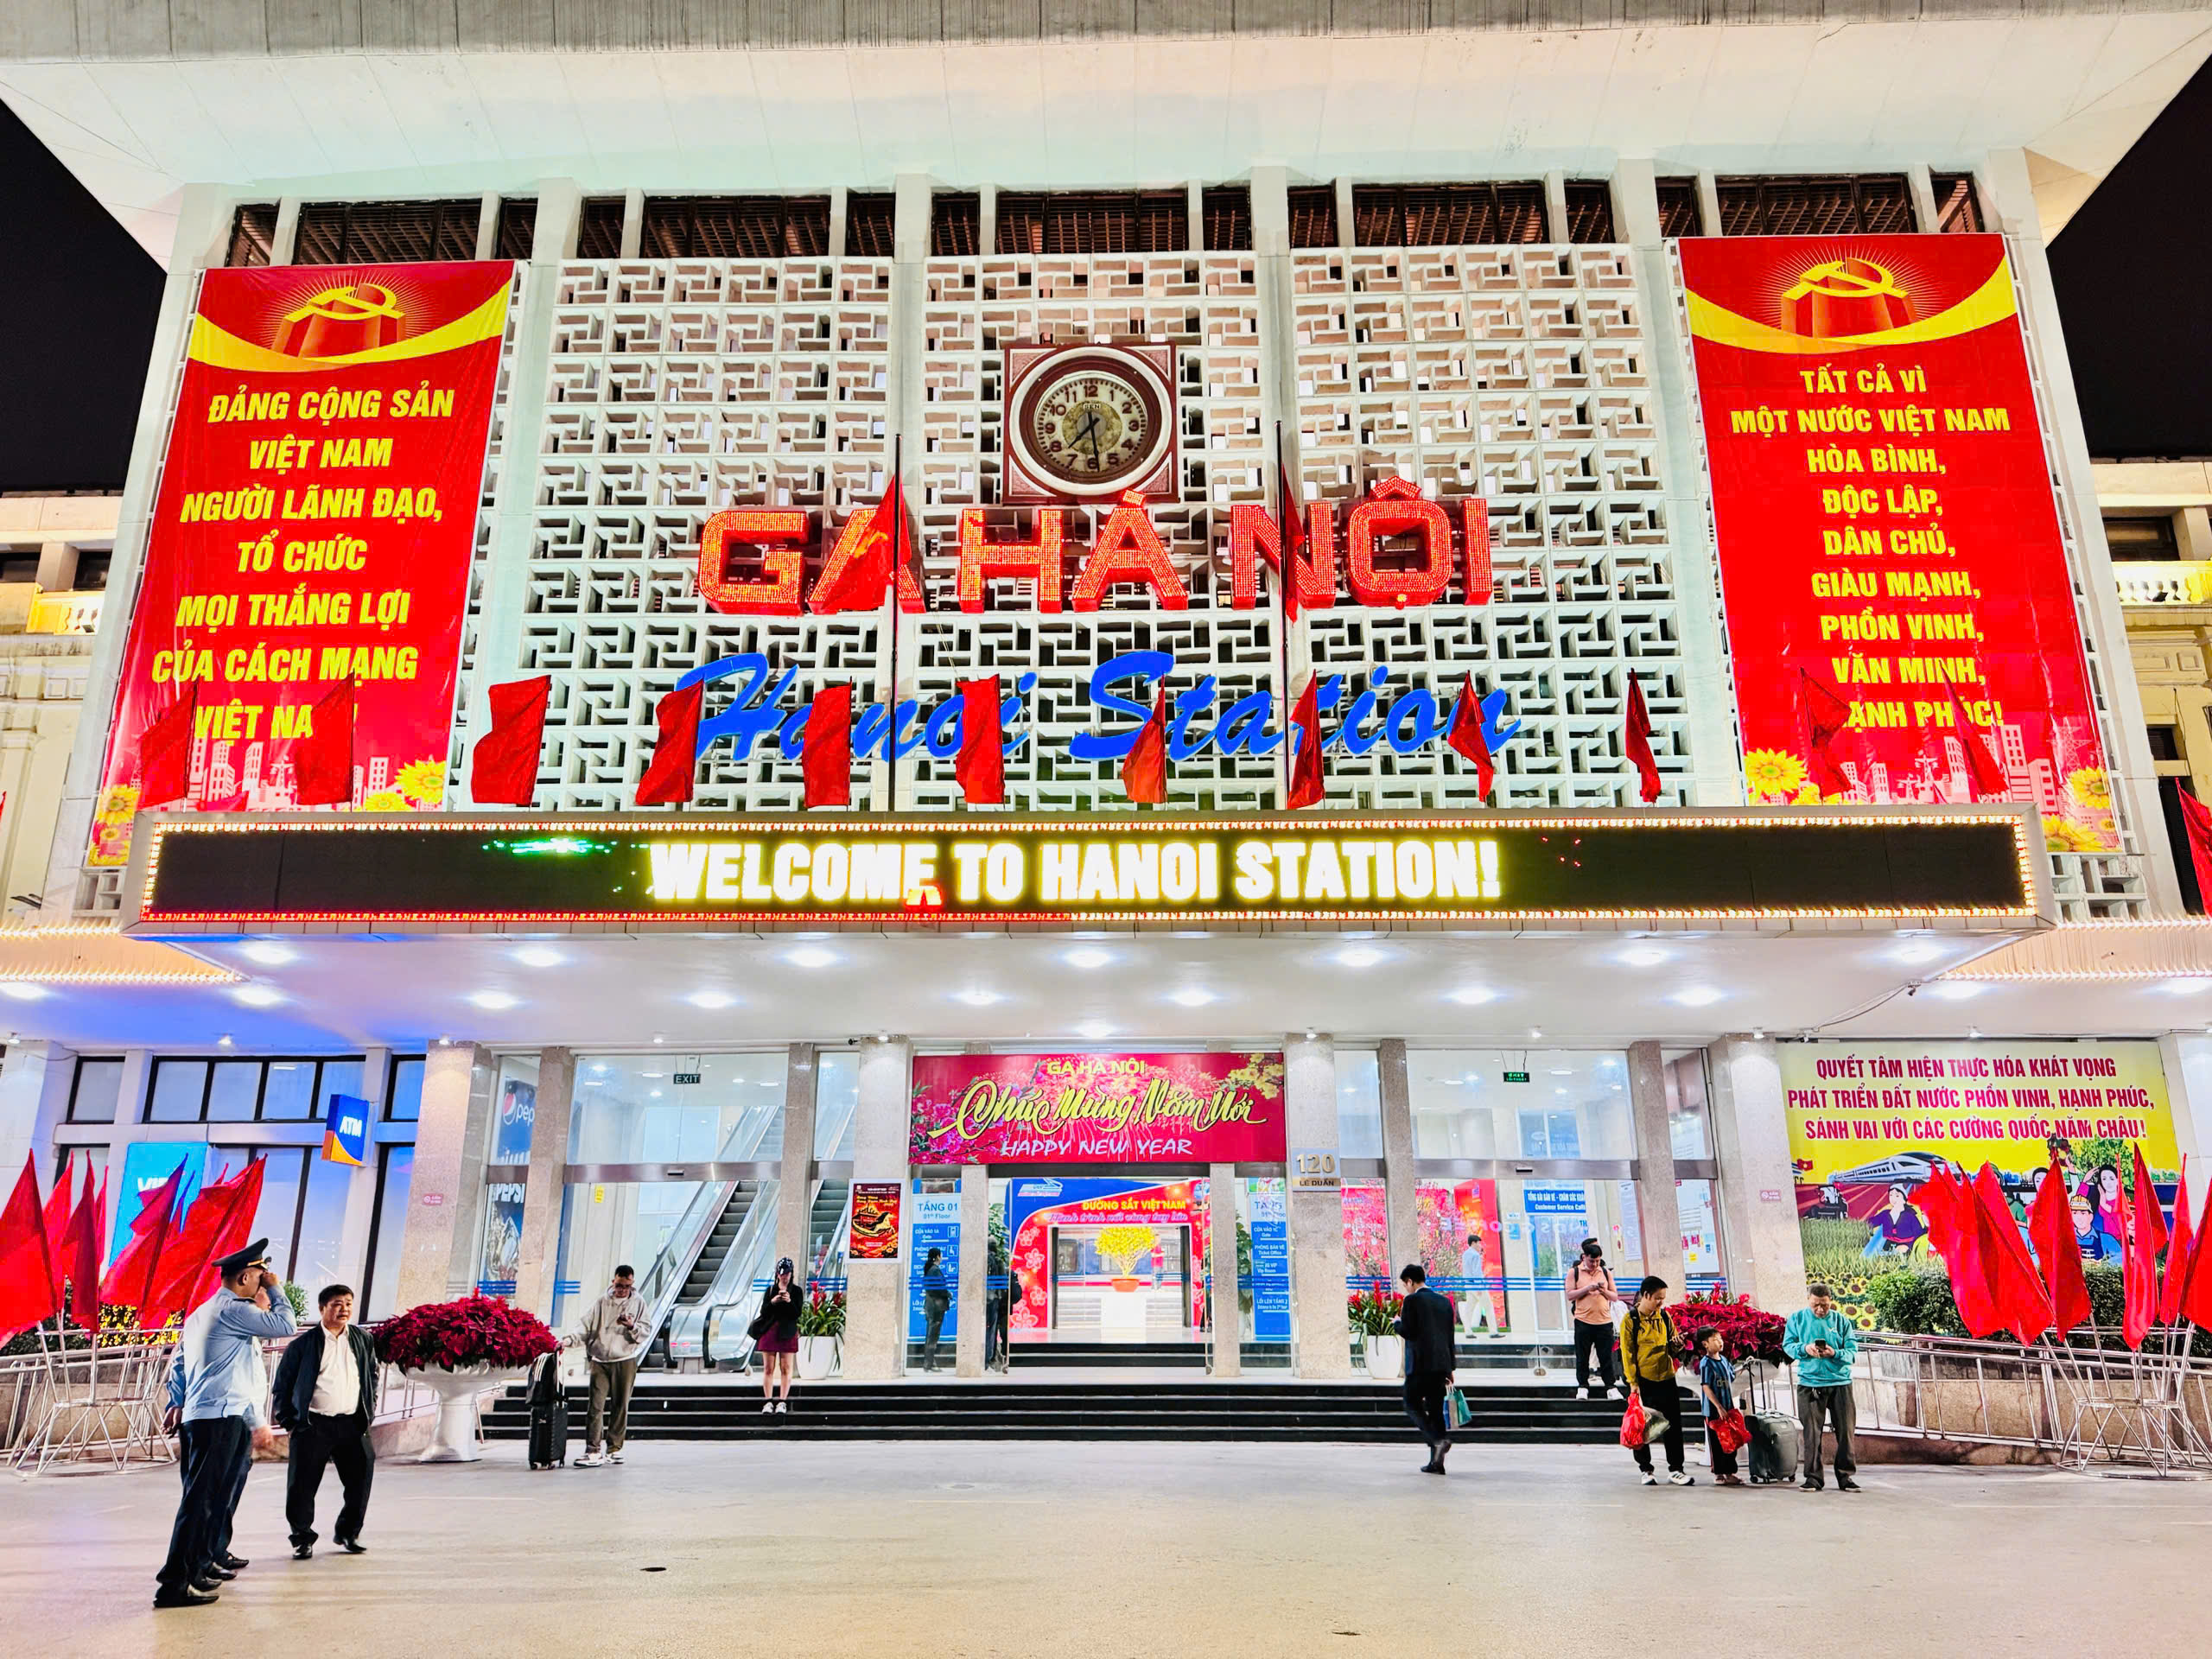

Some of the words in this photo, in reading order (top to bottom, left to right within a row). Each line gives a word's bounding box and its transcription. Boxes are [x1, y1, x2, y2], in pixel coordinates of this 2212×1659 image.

[1800, 362, 1847, 392] TẤT
[1857, 363, 1894, 392] CẢ
[1899, 365, 1926, 392] VÌ
[208, 385, 290, 423] ĐẢNG
[298, 386, 381, 427] CỘNG
[390, 380, 454, 418] SẢN
[1065, 391, 1077, 403] 11
[1084, 385, 1098, 397] 12
[1109, 391, 1115, 402] 1
[1051, 404, 1066, 416] 10
[1122, 402, 1133, 414] 2
[1731, 406, 1788, 437] MỘT
[1797, 404, 1872, 432] NƯỚC
[1878, 404, 1936, 437] VIỆT
[1944, 408, 2011, 431] NAM
[1046, 423, 1055, 434] 9
[1128, 420, 1140, 431] 3
[249, 434, 315, 474] VIỆT
[320, 439, 393, 467] NAM
[1051, 441, 1062, 453] 8
[1122, 439, 1134, 450] 4
[1808, 442, 1864, 472] HÒA
[1871, 443, 1947, 474] BÌNH,
[1066, 454, 1077, 467] 7
[1087, 458, 1098, 469] 6
[1108, 454, 1119, 466] 5
[179, 484, 275, 523] NGƯỜI
[282, 485, 365, 519] LÃNH
[372, 487, 443, 524] ĐẠO,
[1823, 484, 1878, 518] ĐỘC
[1885, 484, 1943, 518] LẬP,
[238, 529, 279, 573] TỔ
[283, 535, 368, 573] CHỨC
[958, 490, 1189, 613] HÀ
[1230, 475, 1492, 610] NỘI
[1823, 526, 1882, 555] DÂN
[1890, 522, 1956, 557] CHỦ,
[1812, 567, 1878, 598] GIÀU
[1885, 571, 1981, 602] MẠNH,
[175, 594, 239, 632] MỌI
[248, 581, 351, 626] THẮNG
[359, 588, 411, 631] LỢI
[1821, 606, 1899, 640] PHỒN
[1906, 614, 1985, 643] VINH,
[152, 639, 214, 684] CỦA
[225, 642, 311, 683] CÁCH
[319, 646, 419, 687] MẠNG
[1832, 652, 1891, 683] VĂN
[1898, 658, 1986, 686] MINH,
[194, 698, 263, 747] VIỆT
[1841, 701, 1908, 734] ẠNH
[650, 842, 938, 900] WELCOME
[952, 842, 1025, 901] TO
[1040, 842, 1219, 900] HANOI
[1235, 841, 1501, 899] STATION!
[676, 1075, 699, 1084] EXIT
[1047, 1061, 1074, 1074] GA
[1112, 1058, 1145, 1077] NỘI
[1816, 1053, 1863, 1080] QUYẾT
[1869, 1055, 1903, 1077] TÂM
[1908, 1055, 1944, 1081] HIỆN
[1948, 1058, 1989, 1081] THỰC
[1993, 1054, 2026, 1077] HÓA
[2030, 1054, 2069, 1077] KHÁT
[2072, 1058, 2117, 1081] VỌNG
[927, 1080, 1065, 1140] Chúc
[1053, 1085, 1137, 1132] Mừng
[1135, 1077, 1213, 1132] Năm
[1204, 1090, 1268, 1123] Mới
[1788, 1085, 1827, 1108] PHÁT
[1832, 1083, 1878, 1109] TRIỂN
[1882, 1082, 1911, 1109] ĐẤT
[1916, 1085, 1960, 1109] NƯỚC
[1965, 1081, 2009, 1108] PHỒN
[2012, 1089, 2056, 1110] VINH,
[2058, 1089, 2103, 1111] HẠNH
[2106, 1085, 2155, 1109] PHÚC,
[340, 1116, 363, 1138] ATM
[1805, 1116, 1849, 1140] SÁNH
[1853, 1121, 1878, 1140] VAI
[1882, 1116, 1909, 1140] VỚI
[1913, 1116, 1945, 1139] CÁC
[1948, 1116, 2004, 1139] CƯỜNG
[2008, 1113, 2051, 1140] QUỐC
[2054, 1116, 2093, 1139] NĂM
[1001, 1140, 1071, 1156] HAPPY
[1078, 1140, 1128, 1155] NEW
[1138, 1138, 1192, 1155] YEAR
[1296, 1154, 1336, 1173] 120
[495, 1183, 525, 1204] PEPSI
[948, 1203, 957, 1211] 01
[1083, 1198, 1119, 1211] ĐƯỜNG
[1121, 1197, 1139, 1211] SẮT
[1141, 1198, 1161, 1211] VIỆT
[1162, 1200, 1186, 1210] NAM
